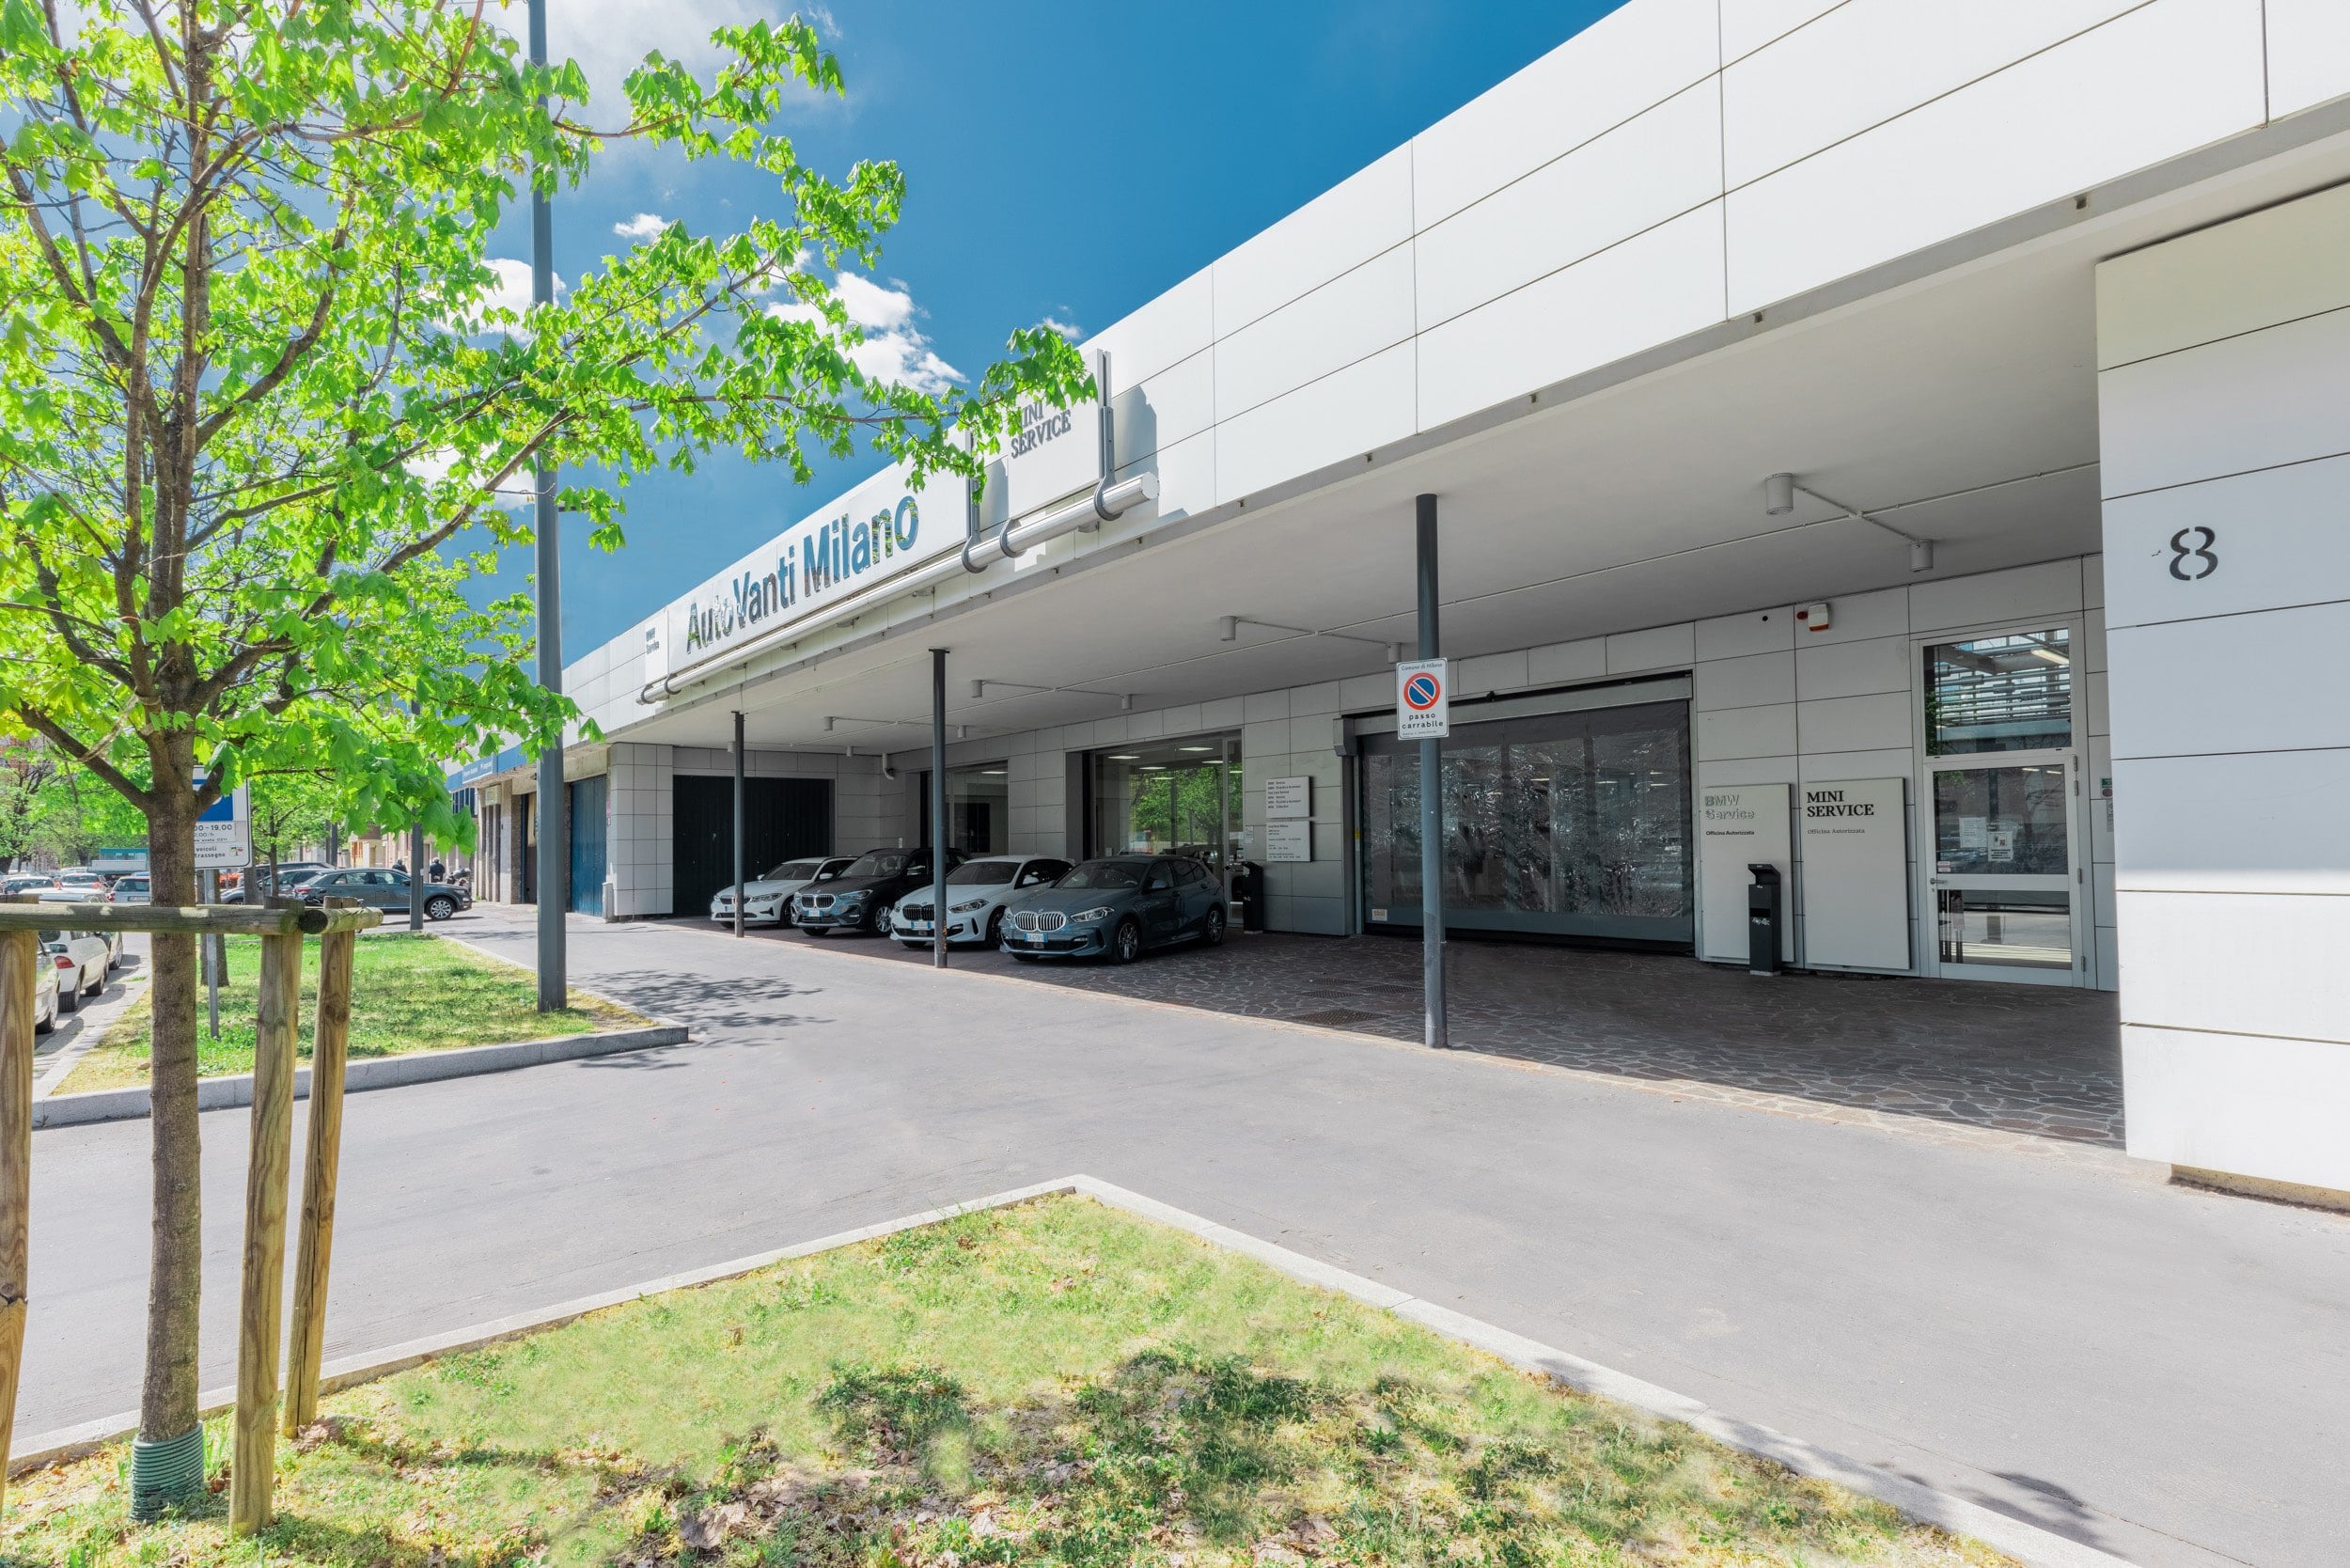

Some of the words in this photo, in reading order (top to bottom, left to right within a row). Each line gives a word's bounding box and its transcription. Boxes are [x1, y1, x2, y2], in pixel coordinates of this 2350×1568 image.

[1021, 401, 1044, 429] INI
[1010, 409, 1072, 460] SERVICE
[2169, 526, 2218, 581] 8
[687, 545, 796, 655] AutoVanti
[803, 495, 918, 598] Milano
[1409, 713, 1435, 722] passo
[1705, 794, 1740, 807] BMW
[1807, 790, 1844, 804] MINI
[1705, 808, 1755, 821] Service
[1807, 804, 1874, 818] SERVICE
